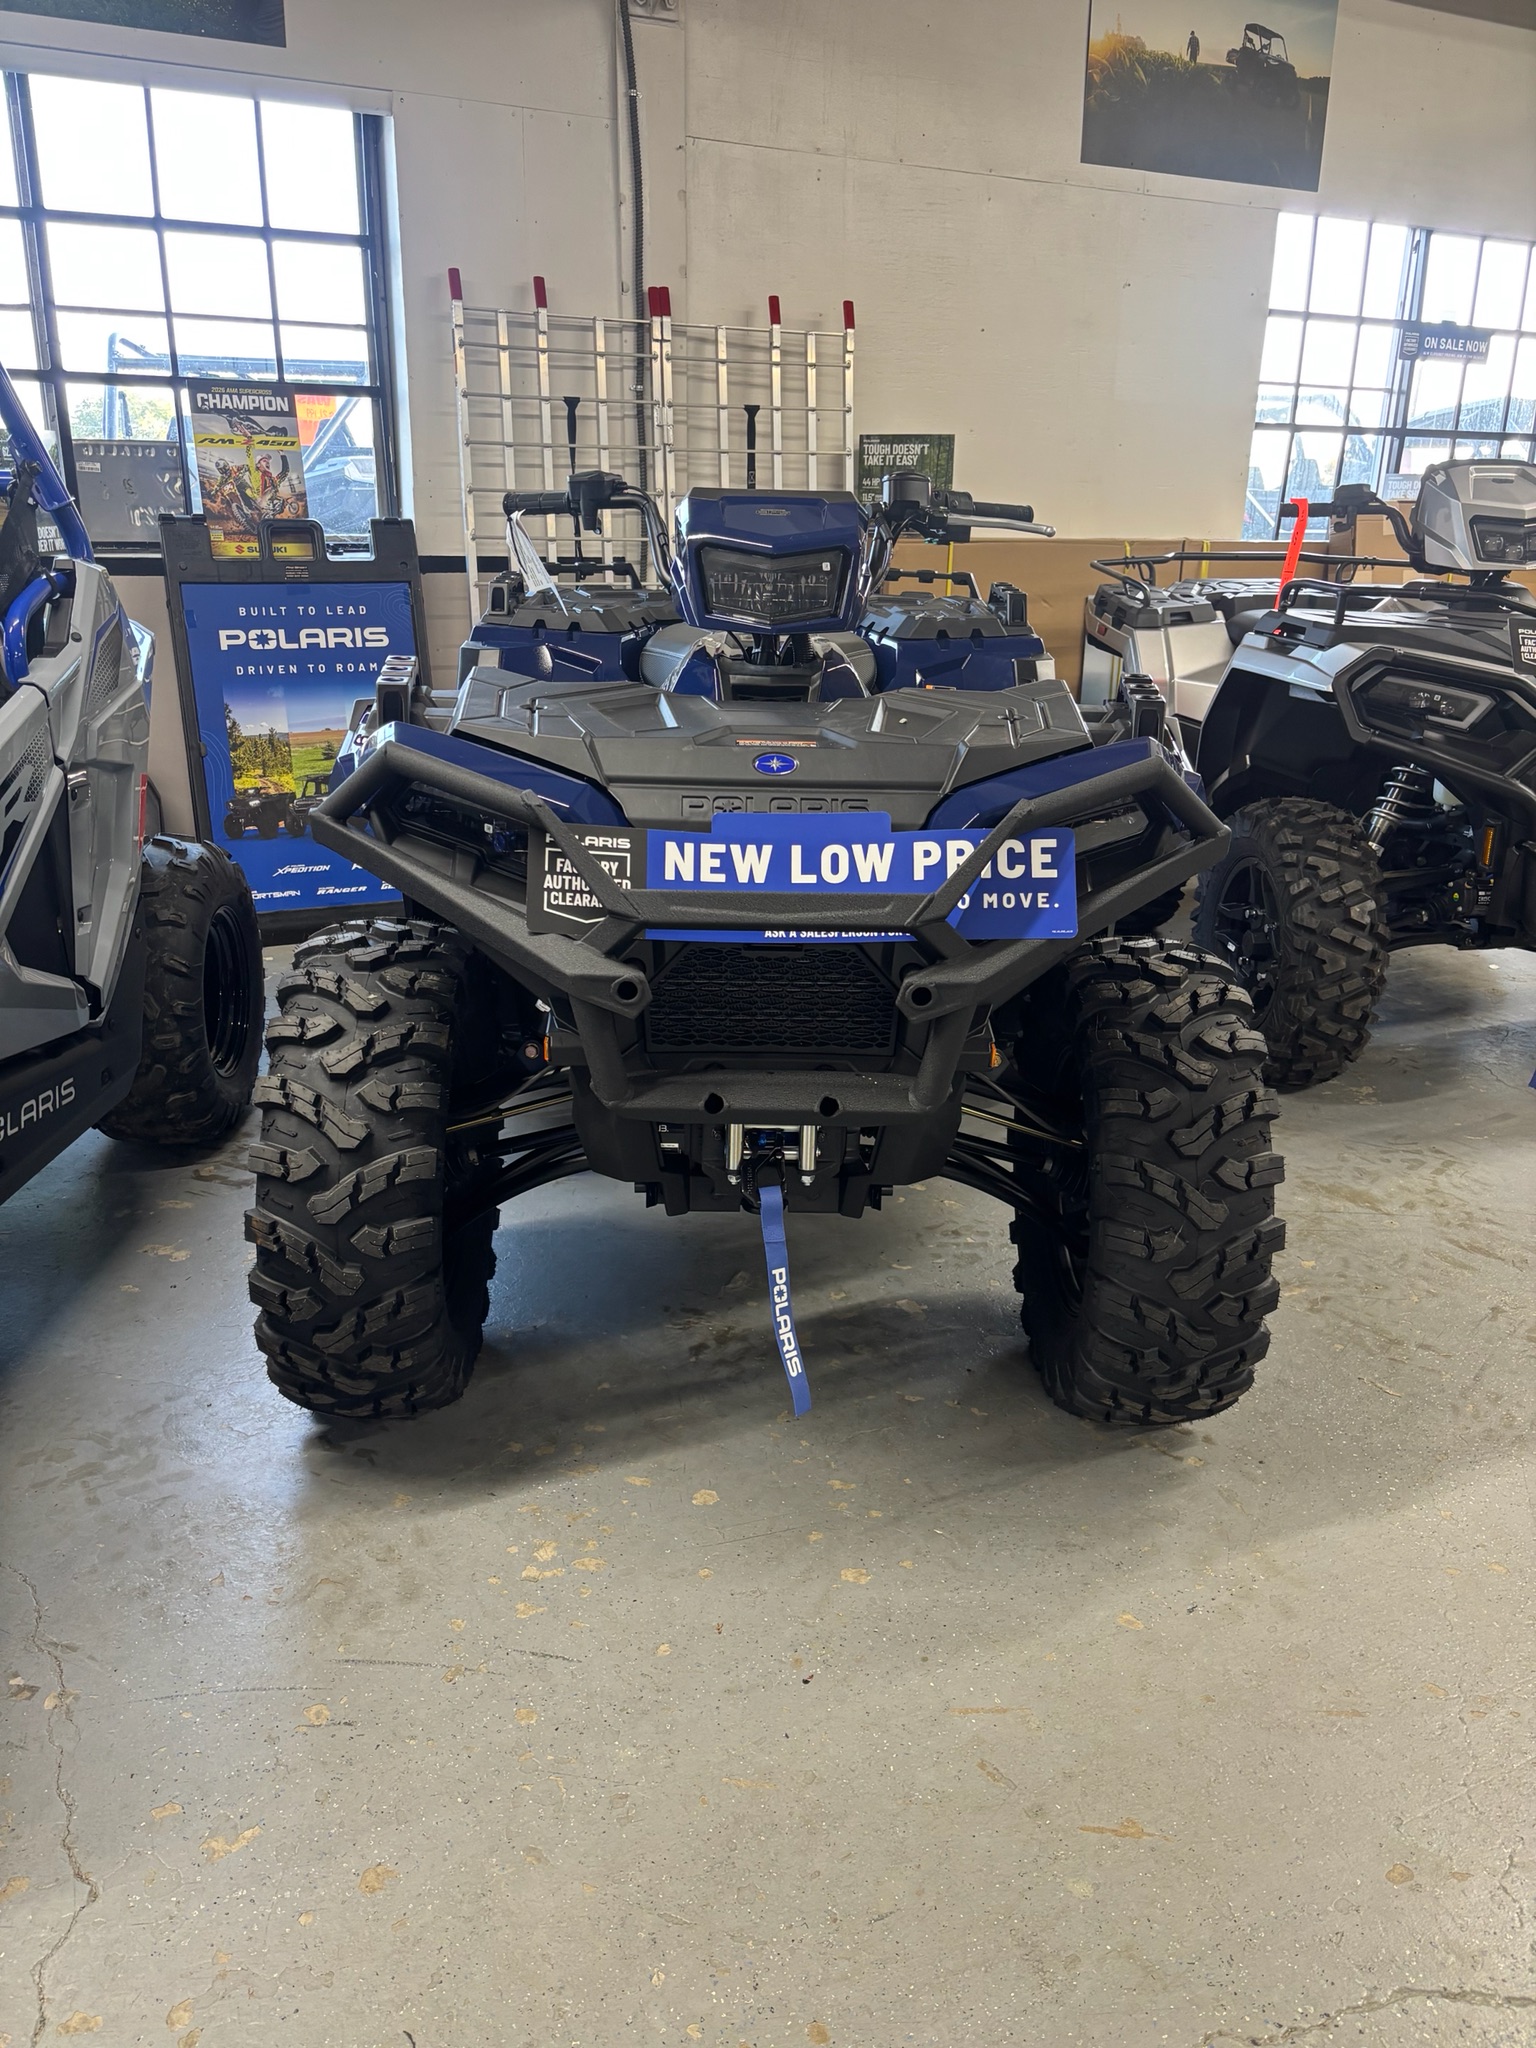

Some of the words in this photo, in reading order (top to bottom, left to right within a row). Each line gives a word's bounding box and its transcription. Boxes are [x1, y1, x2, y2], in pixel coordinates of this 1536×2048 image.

[1424, 336, 1438, 349] ON
[1440, 337, 1465, 351] SALE
[1465, 340, 1488, 353] NOW
[196, 393, 289, 412] CHAMPION
[863, 444, 891, 455] TOUGH
[893, 443, 930, 455] DOESN'T
[863, 455, 885, 466] TAKE
[886, 455, 895, 466] IT
[896, 454, 918, 466] EASY
[238, 606, 287, 617] BUILT
[297, 606, 316, 616] TO
[326, 605, 367, 616] LEAD
[218, 627, 390, 651] POLARIS
[236, 664, 298, 676] DRIVEN
[307, 664, 326, 674] TO
[336, 662, 378, 674] ROAM
[681, 795, 870, 817] POLARIS
[272, 864, 331, 877] XPEDITION
[556, 858, 619, 876] FARY
[664, 840, 773, 884] NEW
[790, 843, 894, 884] LOW
[251, 889, 301, 900] ORTSMAN
[316, 886, 368, 896] RANGER
[550, 891, 604, 908] CLEARA
[983, 892, 1060, 909] MOVE.
[0, 1077, 76, 1140] LARIS
[771, 1266, 803, 1378] POLARIS
